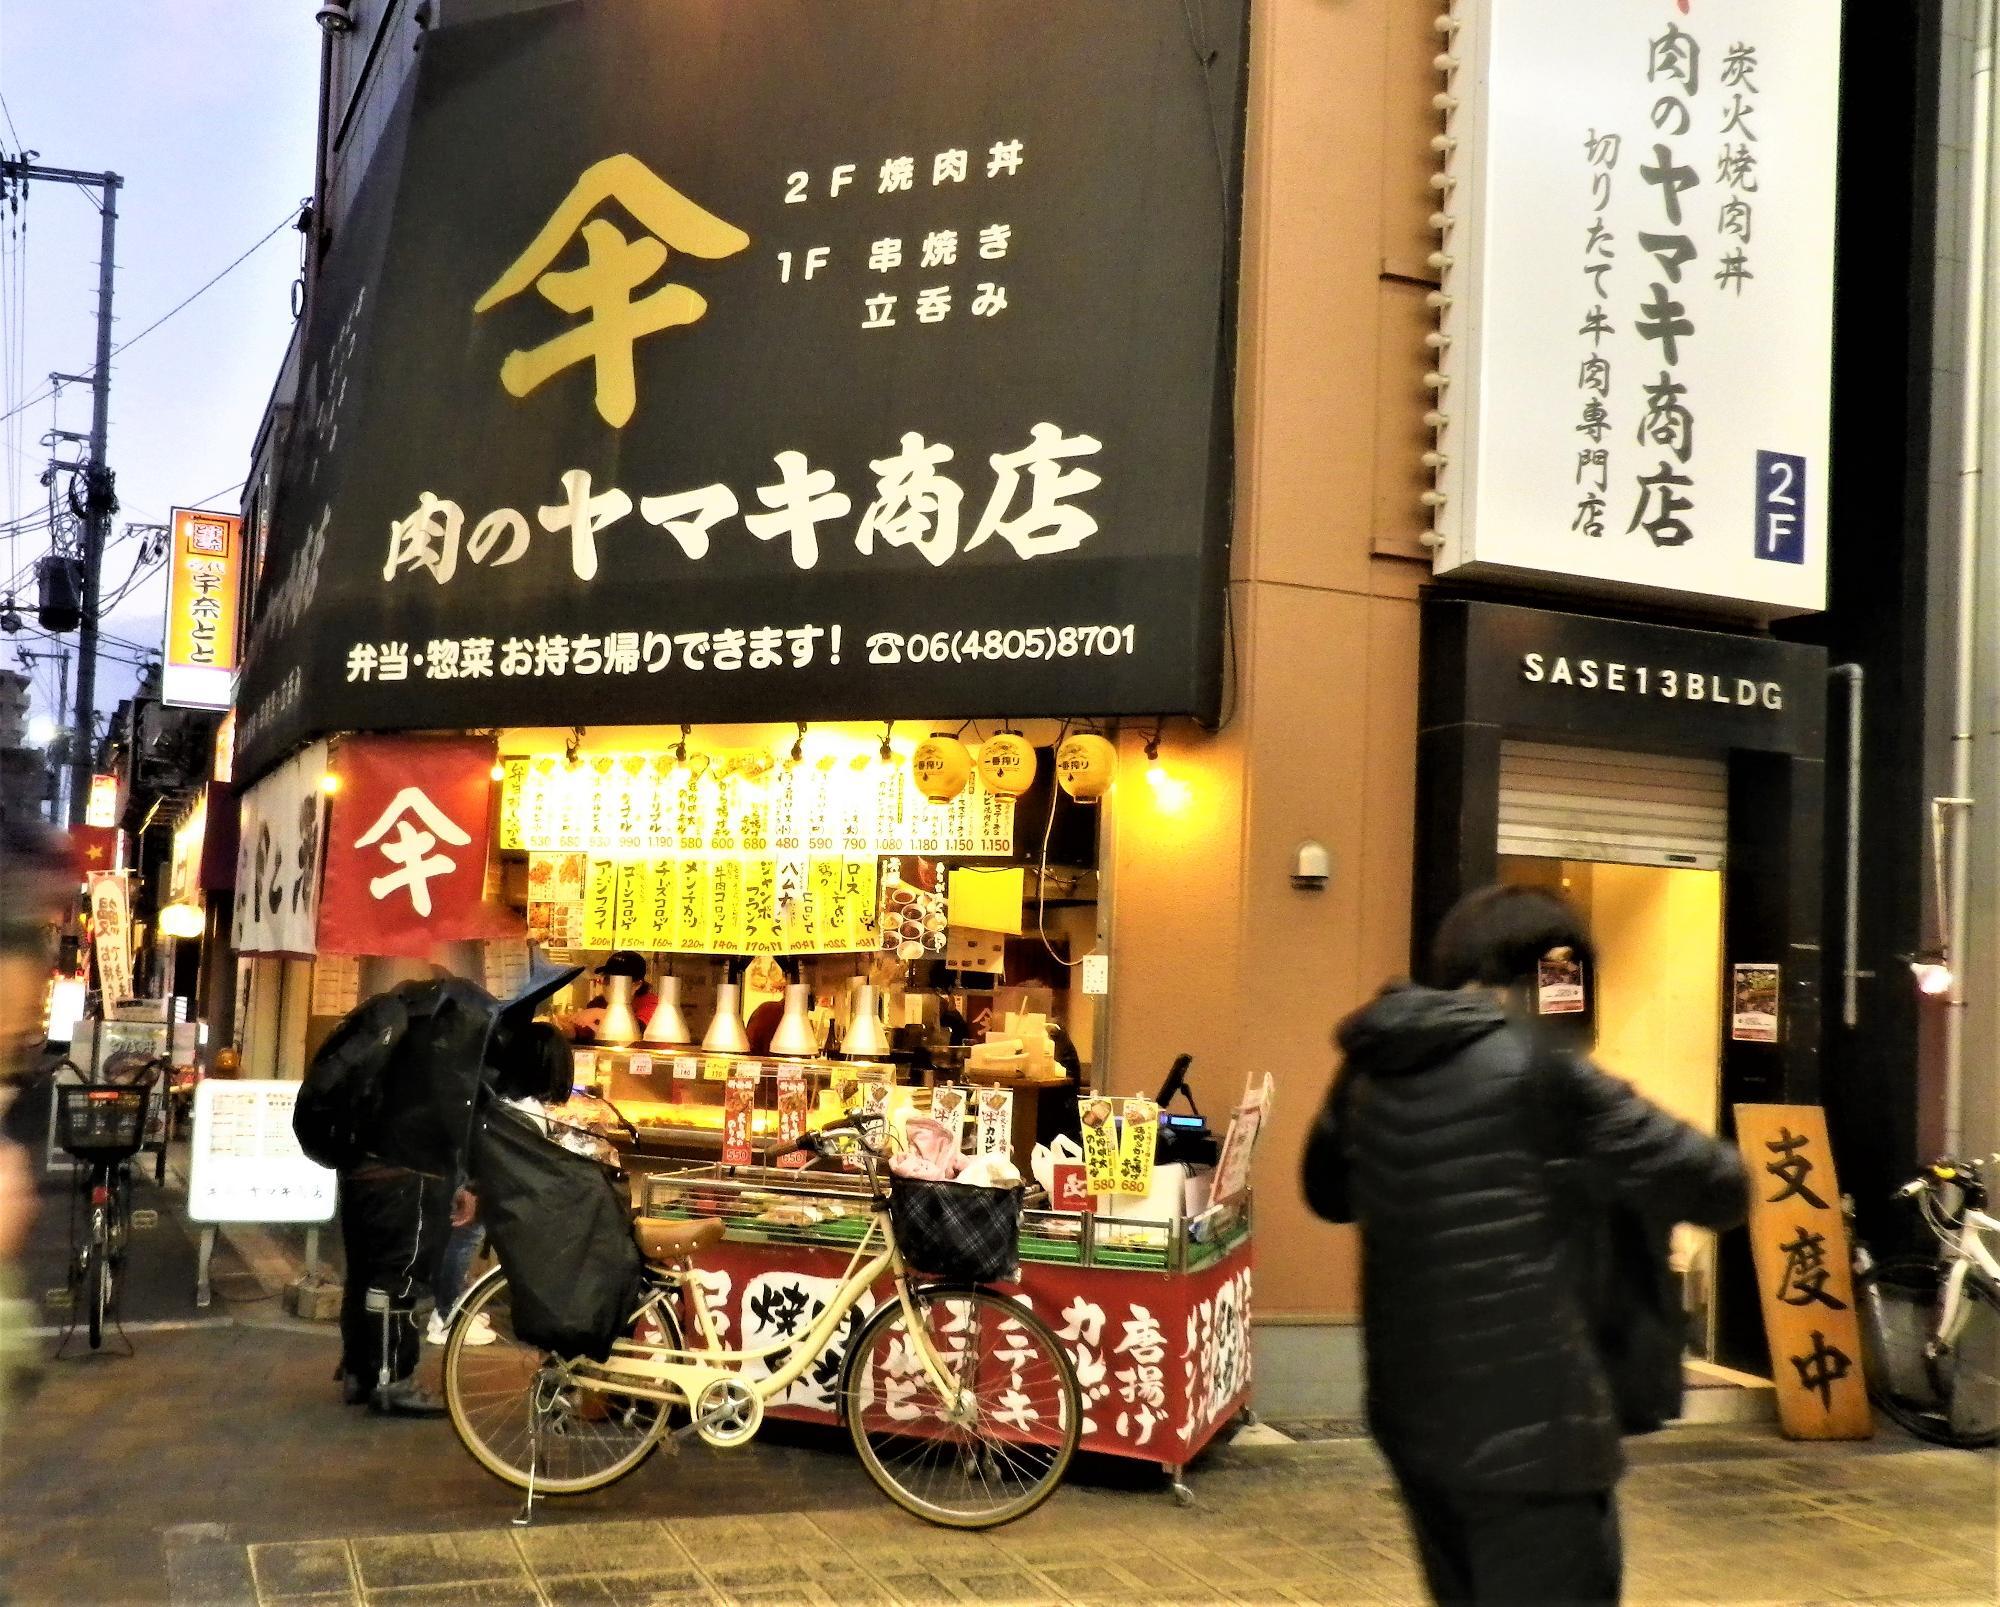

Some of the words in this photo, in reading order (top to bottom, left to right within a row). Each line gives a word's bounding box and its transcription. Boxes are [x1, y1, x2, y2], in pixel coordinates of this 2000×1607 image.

[785, 165, 857, 205] 2F
[877, 139, 1026, 197] 焼肉丼
[1715, 41, 1759, 298] 炭火焼肉丼
[777, 248, 830, 284] 1F
[867, 223, 1015, 276] 串焼き
[1625, 22, 1700, 548] 肉のヤマキ商店
[860, 285, 1010, 331] 立呑み
[1572, 128, 1621, 538] 切りたて牛肉専門店
[382, 420, 1106, 585] 肉のヤマキ商店
[1768, 462, 1796, 552] 2F
[190, 572, 222, 664] 宇奈とと
[907, 623, 1138, 666] 06(4805)8701
[984, 756, 1020, 767] 一番搾り
[619, 836, 641, 848] 990
[680, 837, 702, 849] 580
[711, 837, 734, 849] 600
[744, 837, 767, 849] 680
[775, 837, 799, 849] 480
[809, 837, 833, 849] 590
[843, 837, 867, 850] 790
[594, 860, 613, 930] アジフライ
[620, 866, 637, 931] コーンコロッケ
[653, 861, 671, 932] チーズコロッケ
[681, 861, 699, 928] メンチカツ
[714, 866, 726, 934] 牛肉コロッケ
[1093, 1179, 1116, 1191] 580
[1121, 1179, 1145, 1193] 680
[1765, 1127, 1853, 1413] 支度中
[1113, 1303, 1169, 1446] 唐揚げ
